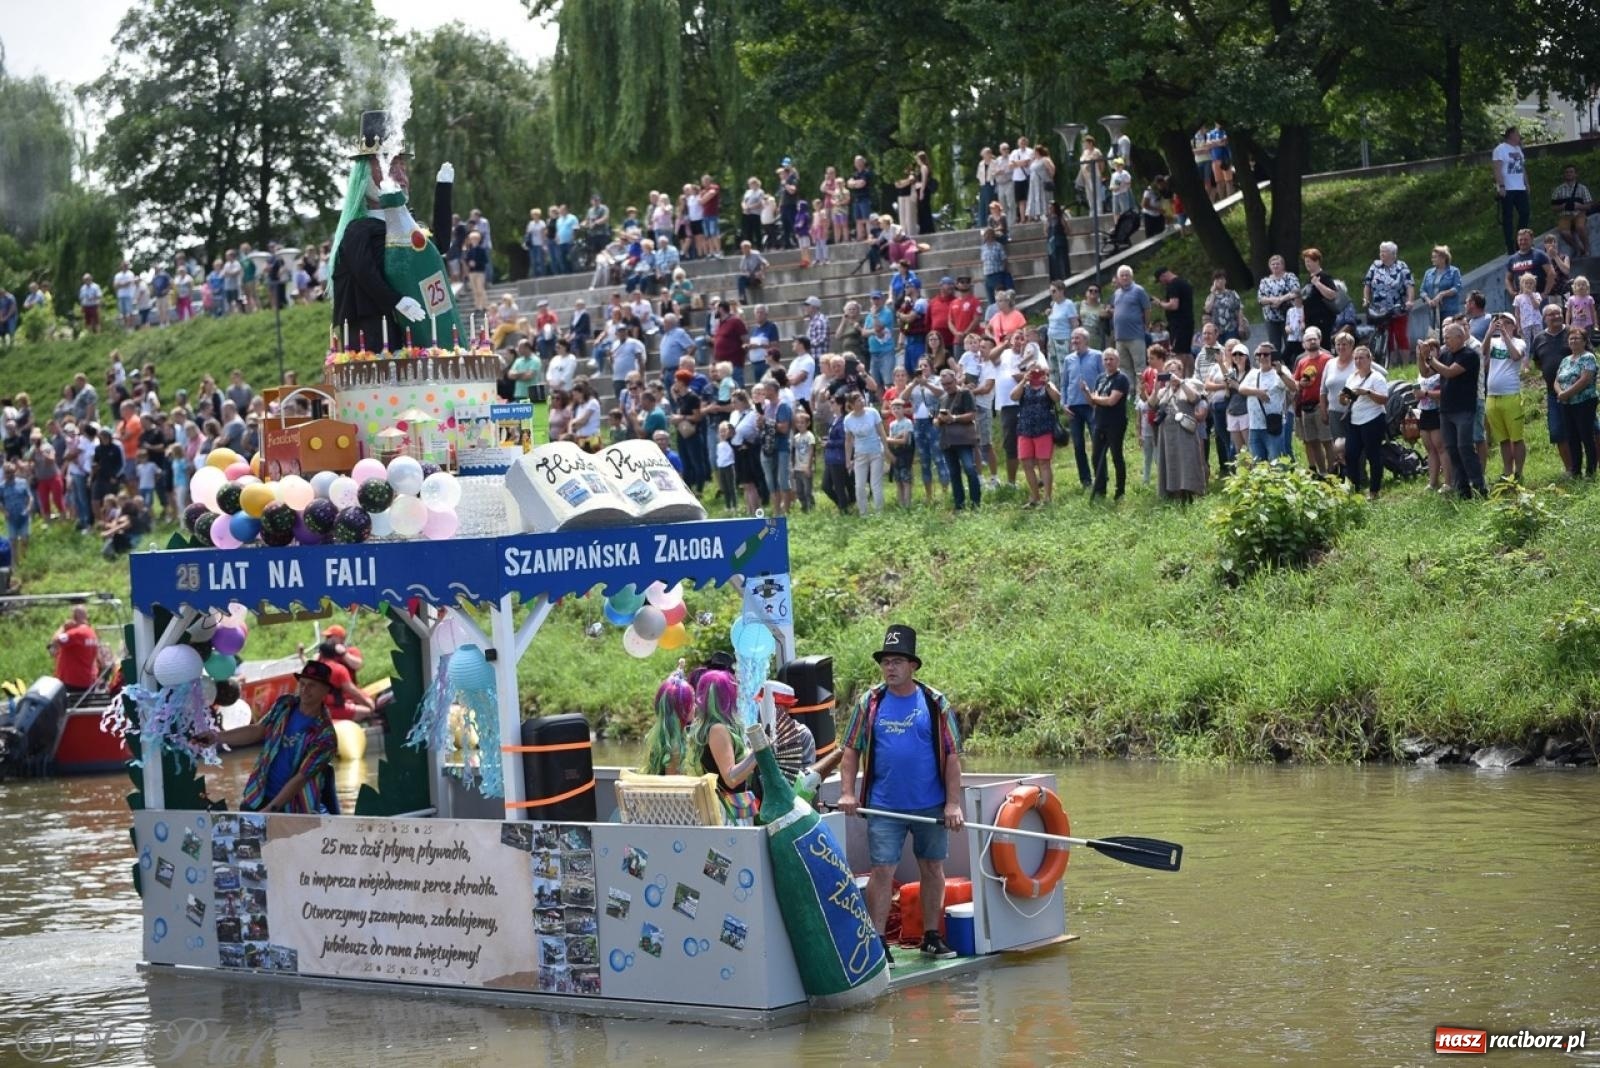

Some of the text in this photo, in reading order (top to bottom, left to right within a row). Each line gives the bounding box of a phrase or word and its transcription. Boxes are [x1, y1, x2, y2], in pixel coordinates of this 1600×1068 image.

[427, 279, 445, 306] 25
[208, 562, 249, 590] LAT
[268, 559, 305, 588] NA
[325, 556, 377, 587] FALI
[778, 598, 788, 617] 6
[885, 632, 901, 645] 25
[320, 836, 471, 866] 25 raz dziś płyną pływadła,
[299, 870, 499, 896] ta impreza niejednemu serce skradła.
[302, 901, 498, 937] Otworzymy szampana, zabalujemy,
[319, 934, 482, 969] jubileusz do rana świętujemy!
